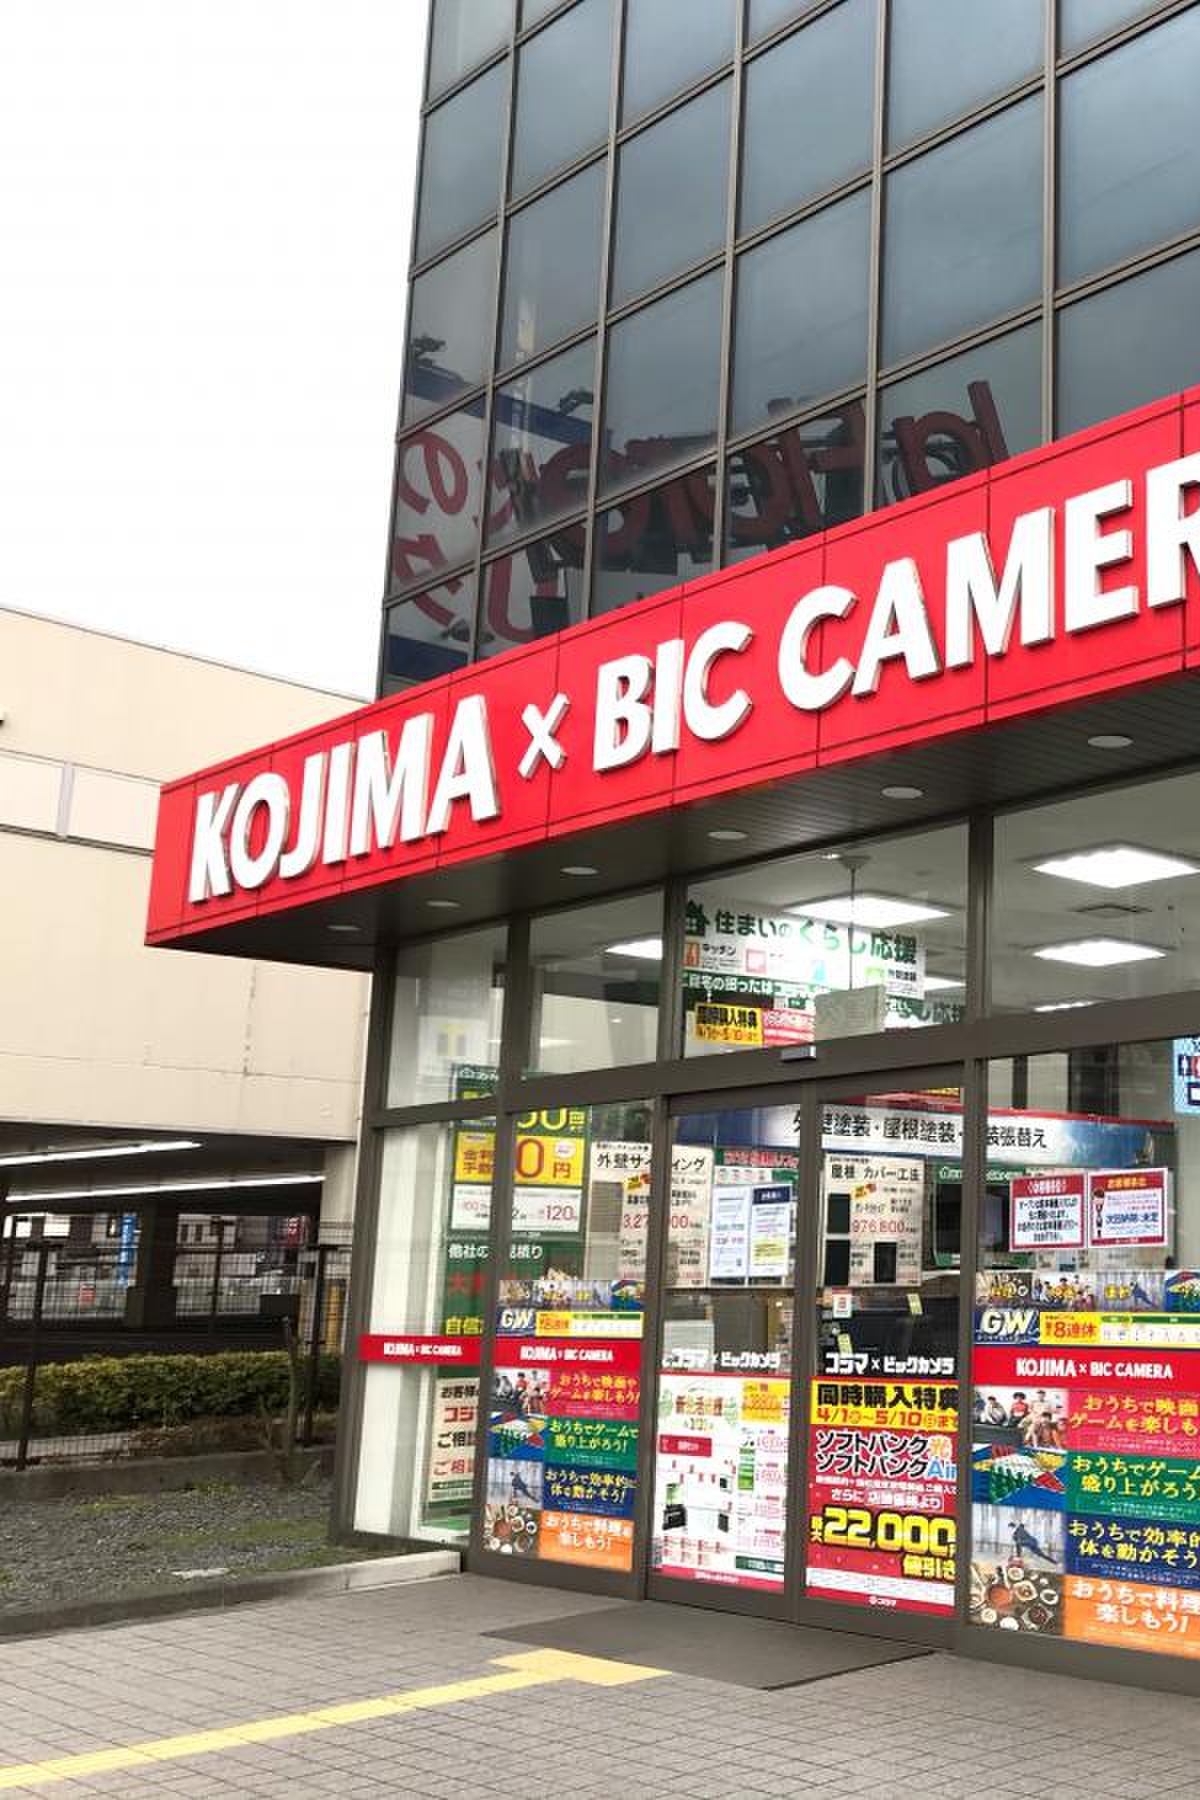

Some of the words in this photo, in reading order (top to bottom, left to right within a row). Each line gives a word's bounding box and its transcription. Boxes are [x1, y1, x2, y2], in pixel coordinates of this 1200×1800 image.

[189, 694, 500, 903] KOJIMA
[593, 620, 753, 772] BIC
[979, 1308, 1037, 1336] GW
[883, 1355, 955, 1375] ビックカメラ
[1016, 1358, 1077, 1377] KOJIMA
[1090, 1360, 1113, 1377] BIC
[1115, 1362, 1173, 1379] CAMERA
[1095, 1604, 1190, 1633] 楽しもう!
